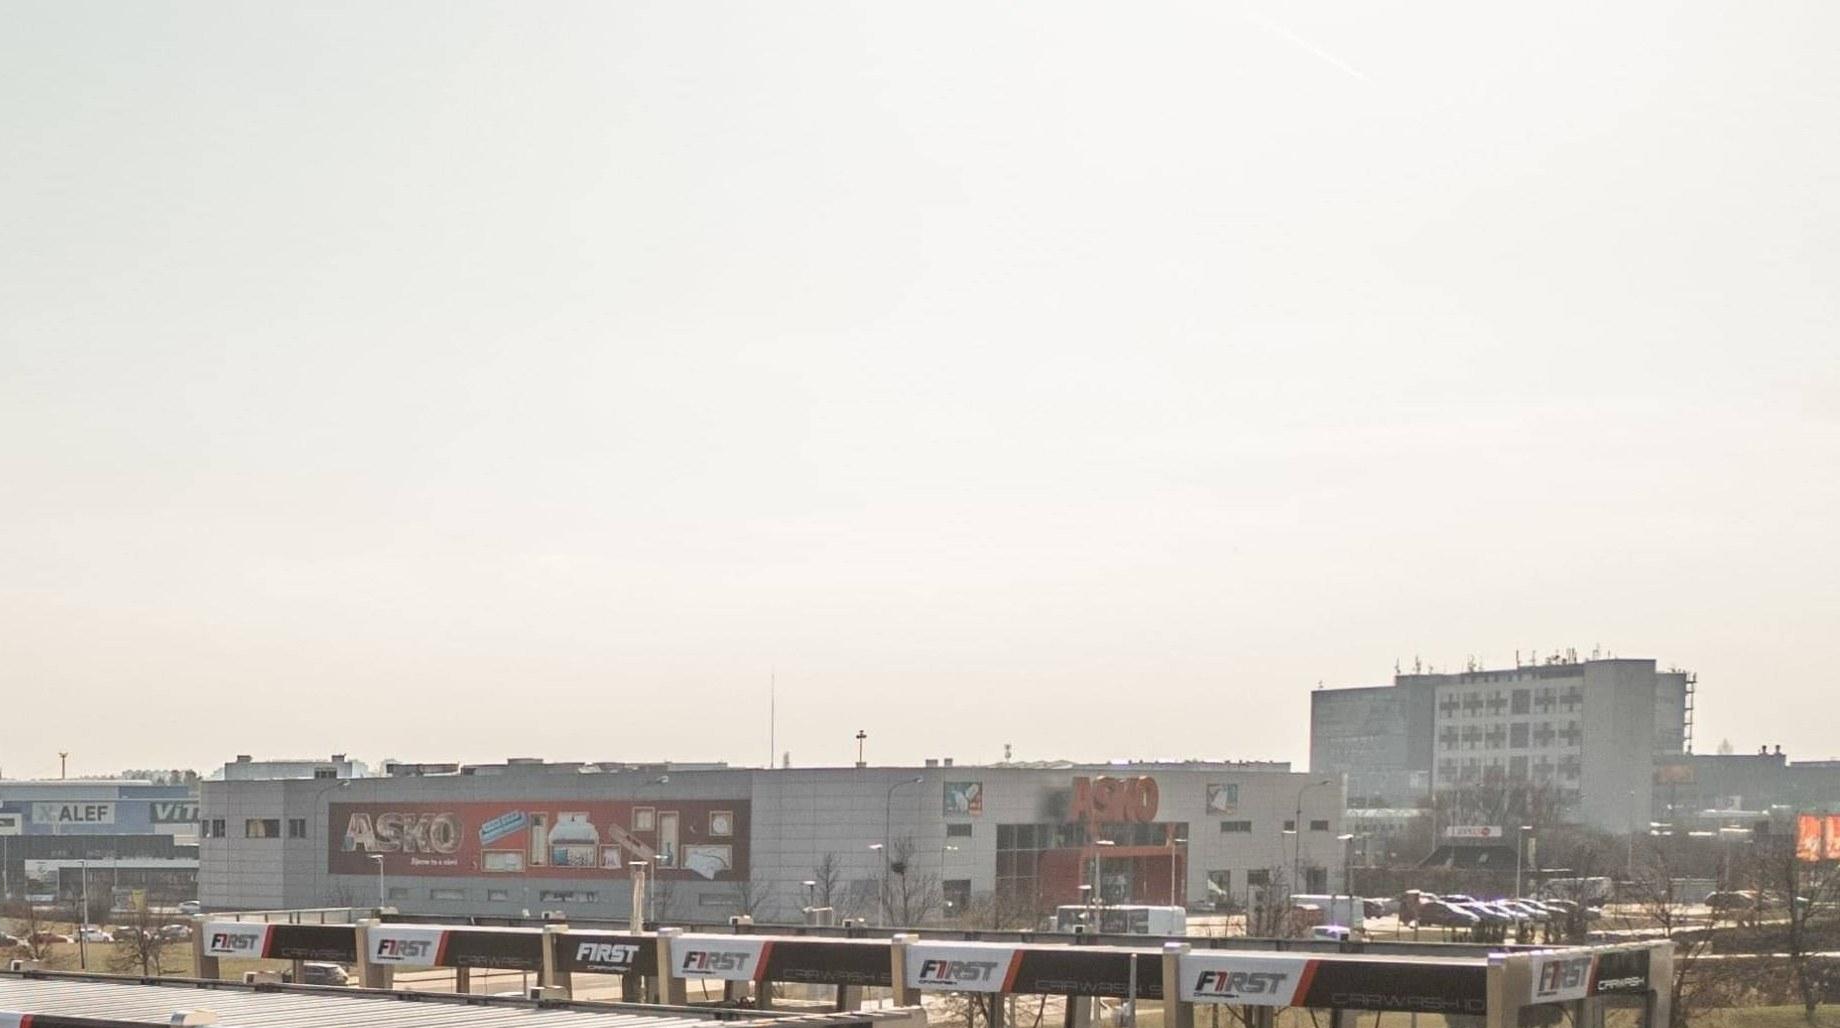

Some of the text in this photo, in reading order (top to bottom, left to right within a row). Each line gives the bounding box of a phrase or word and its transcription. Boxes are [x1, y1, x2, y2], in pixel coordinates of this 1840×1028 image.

[59, 805, 109, 821] ALEF
[155, 803, 200, 820] ViT
[1069, 776, 1158, 822] ASKO
[342, 811, 462, 854] ASKO
